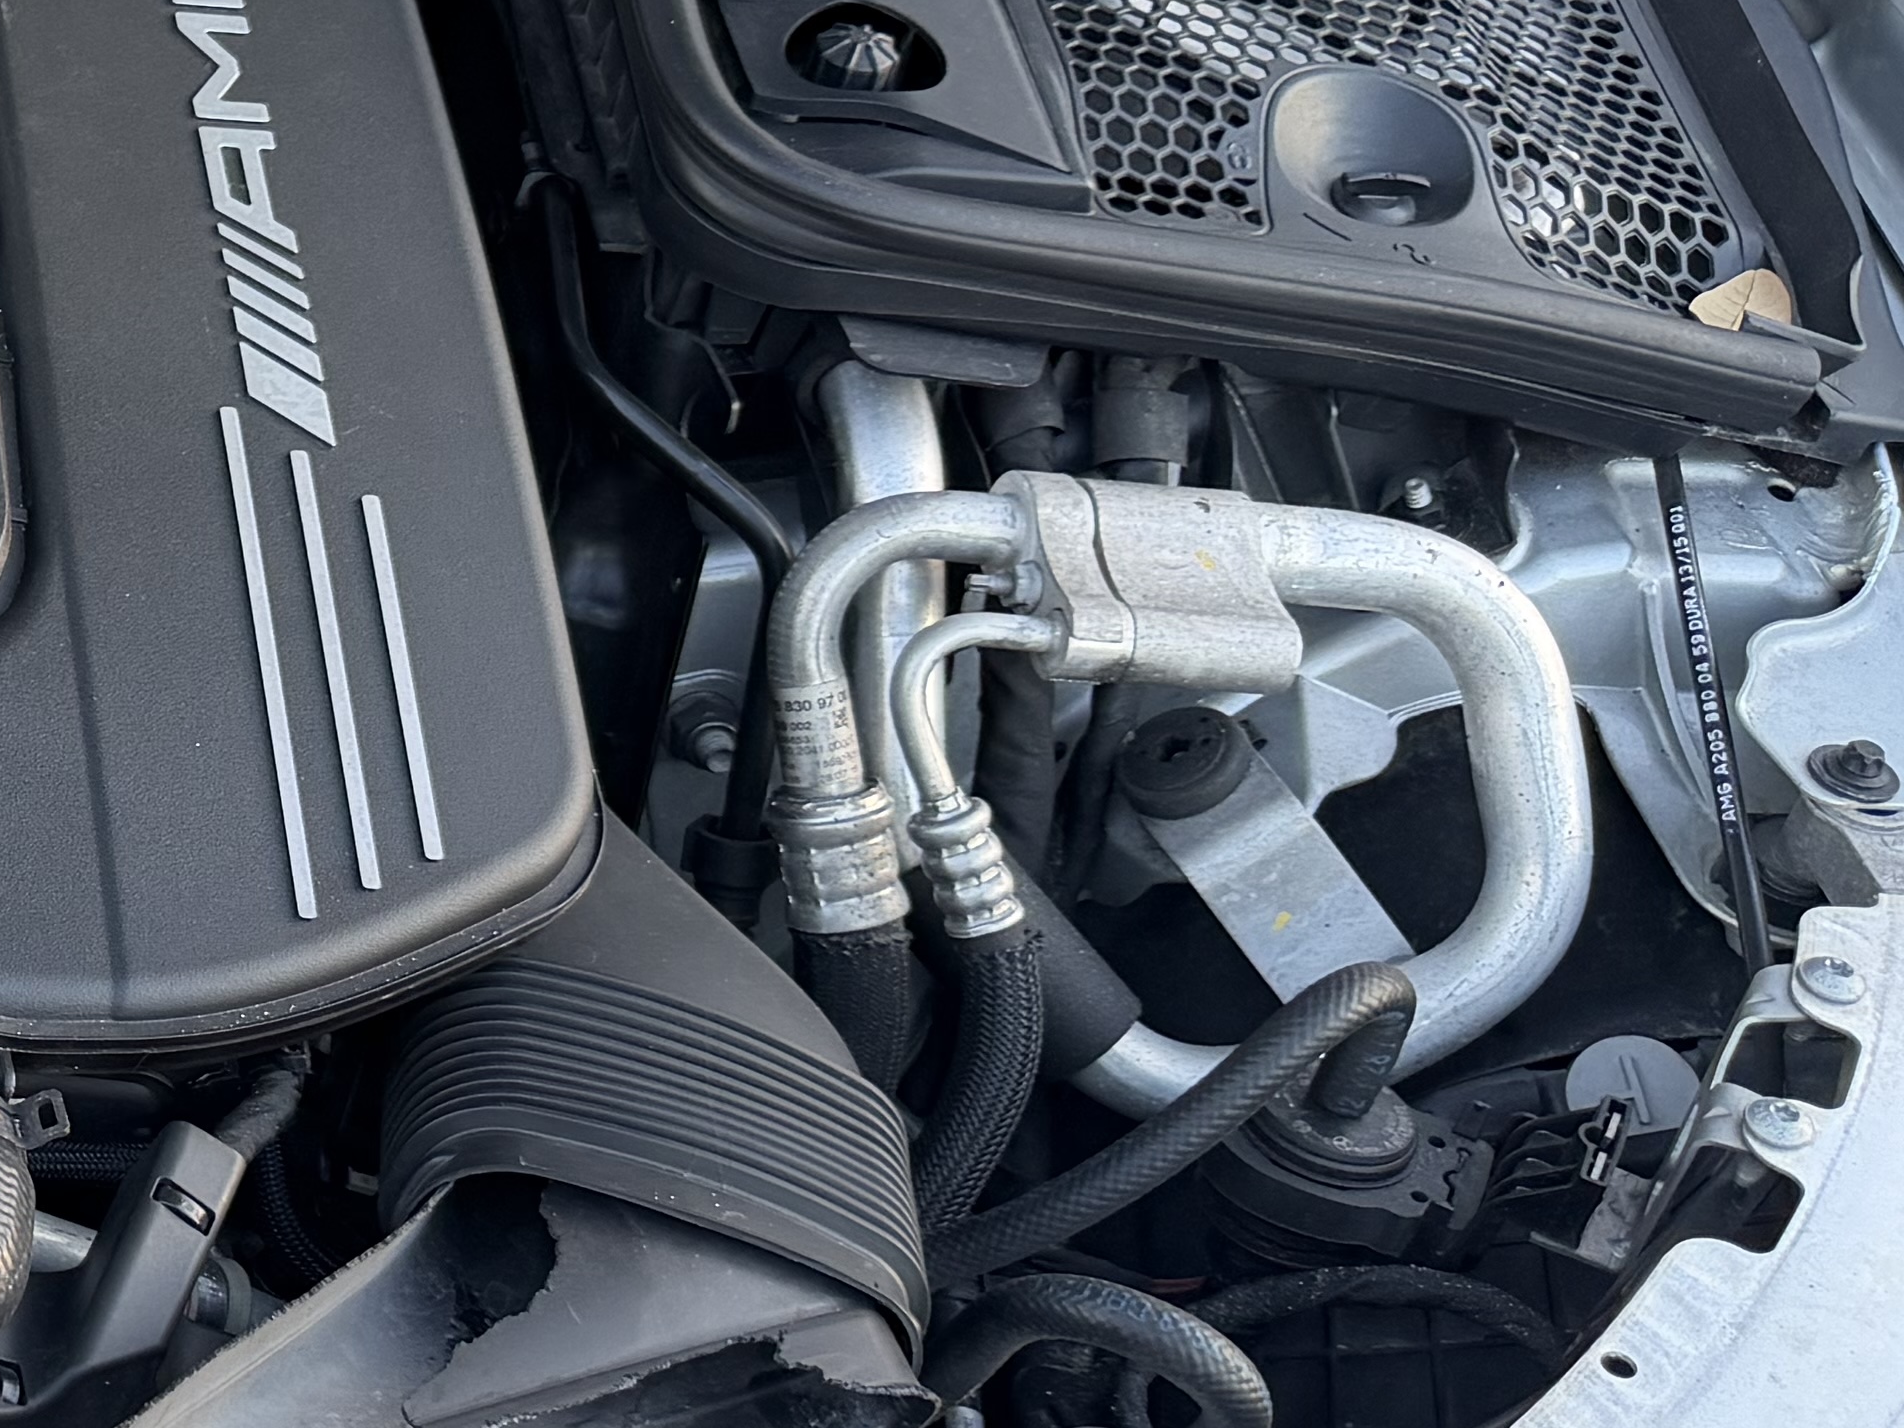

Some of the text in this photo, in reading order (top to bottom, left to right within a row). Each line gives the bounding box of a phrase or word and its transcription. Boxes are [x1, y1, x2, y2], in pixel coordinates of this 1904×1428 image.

[1672, 536, 1696, 584] 13/15
[1681, 586, 1704, 631] DURA
[1694, 661, 1714, 684] 04
[1699, 688, 1721, 724] 880
[1706, 728, 1730, 776] A205
[1715, 781, 1738, 824] AMG
